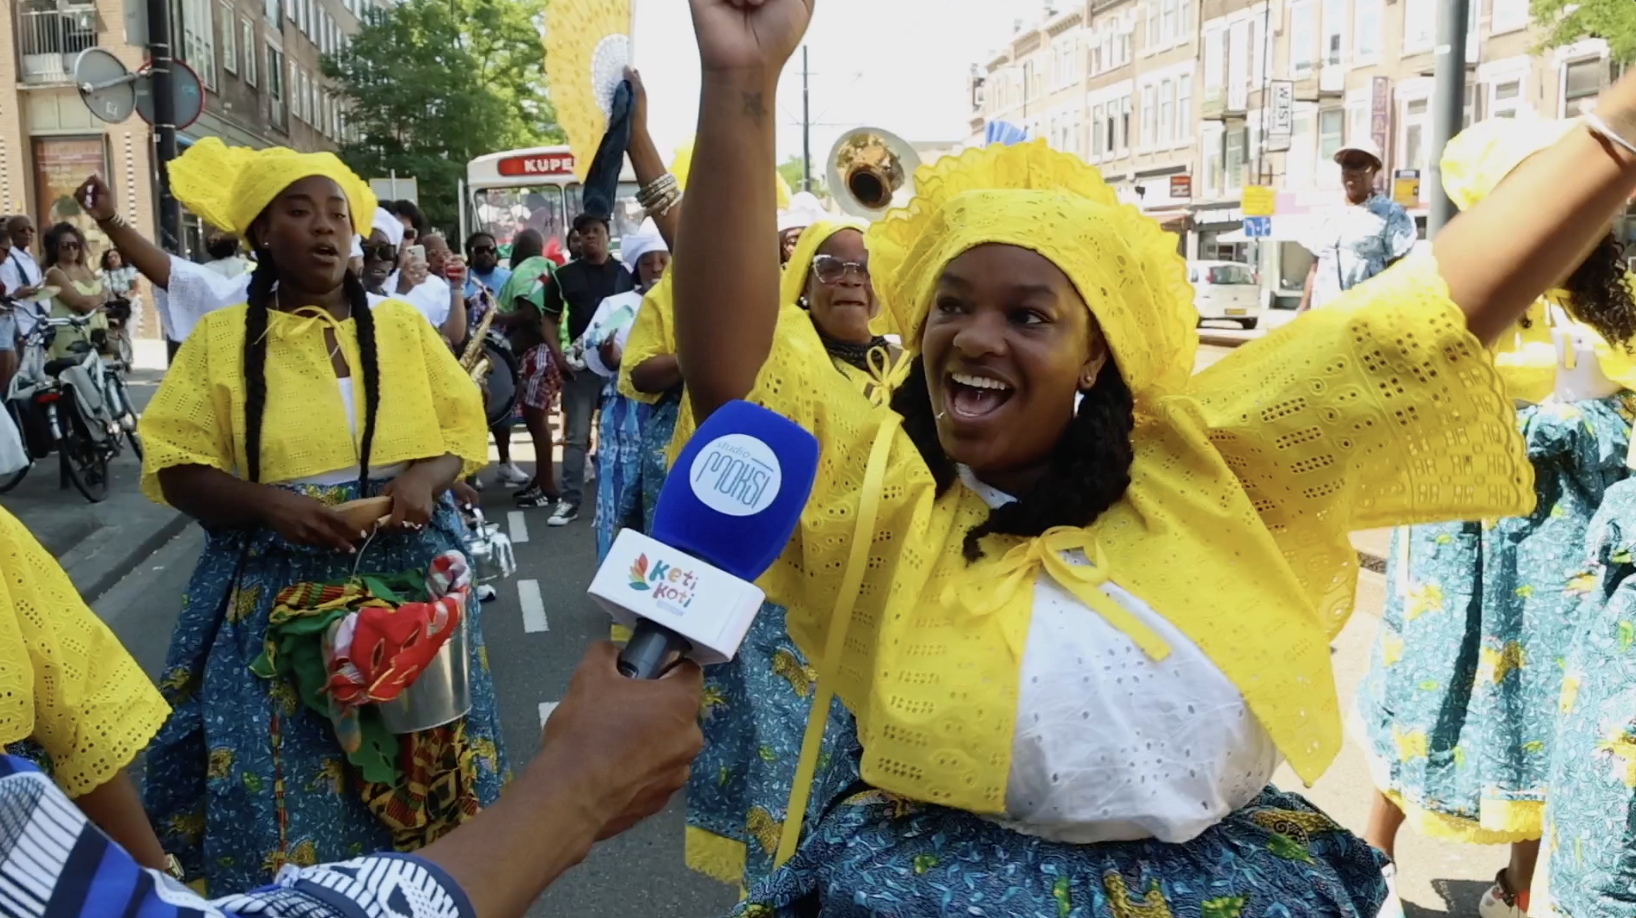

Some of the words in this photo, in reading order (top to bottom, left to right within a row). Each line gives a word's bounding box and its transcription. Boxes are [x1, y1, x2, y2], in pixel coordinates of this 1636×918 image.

[524, 158, 575, 173] KUPE
[717, 441, 751, 459] studio
[696, 451, 771, 509] MOKSI
